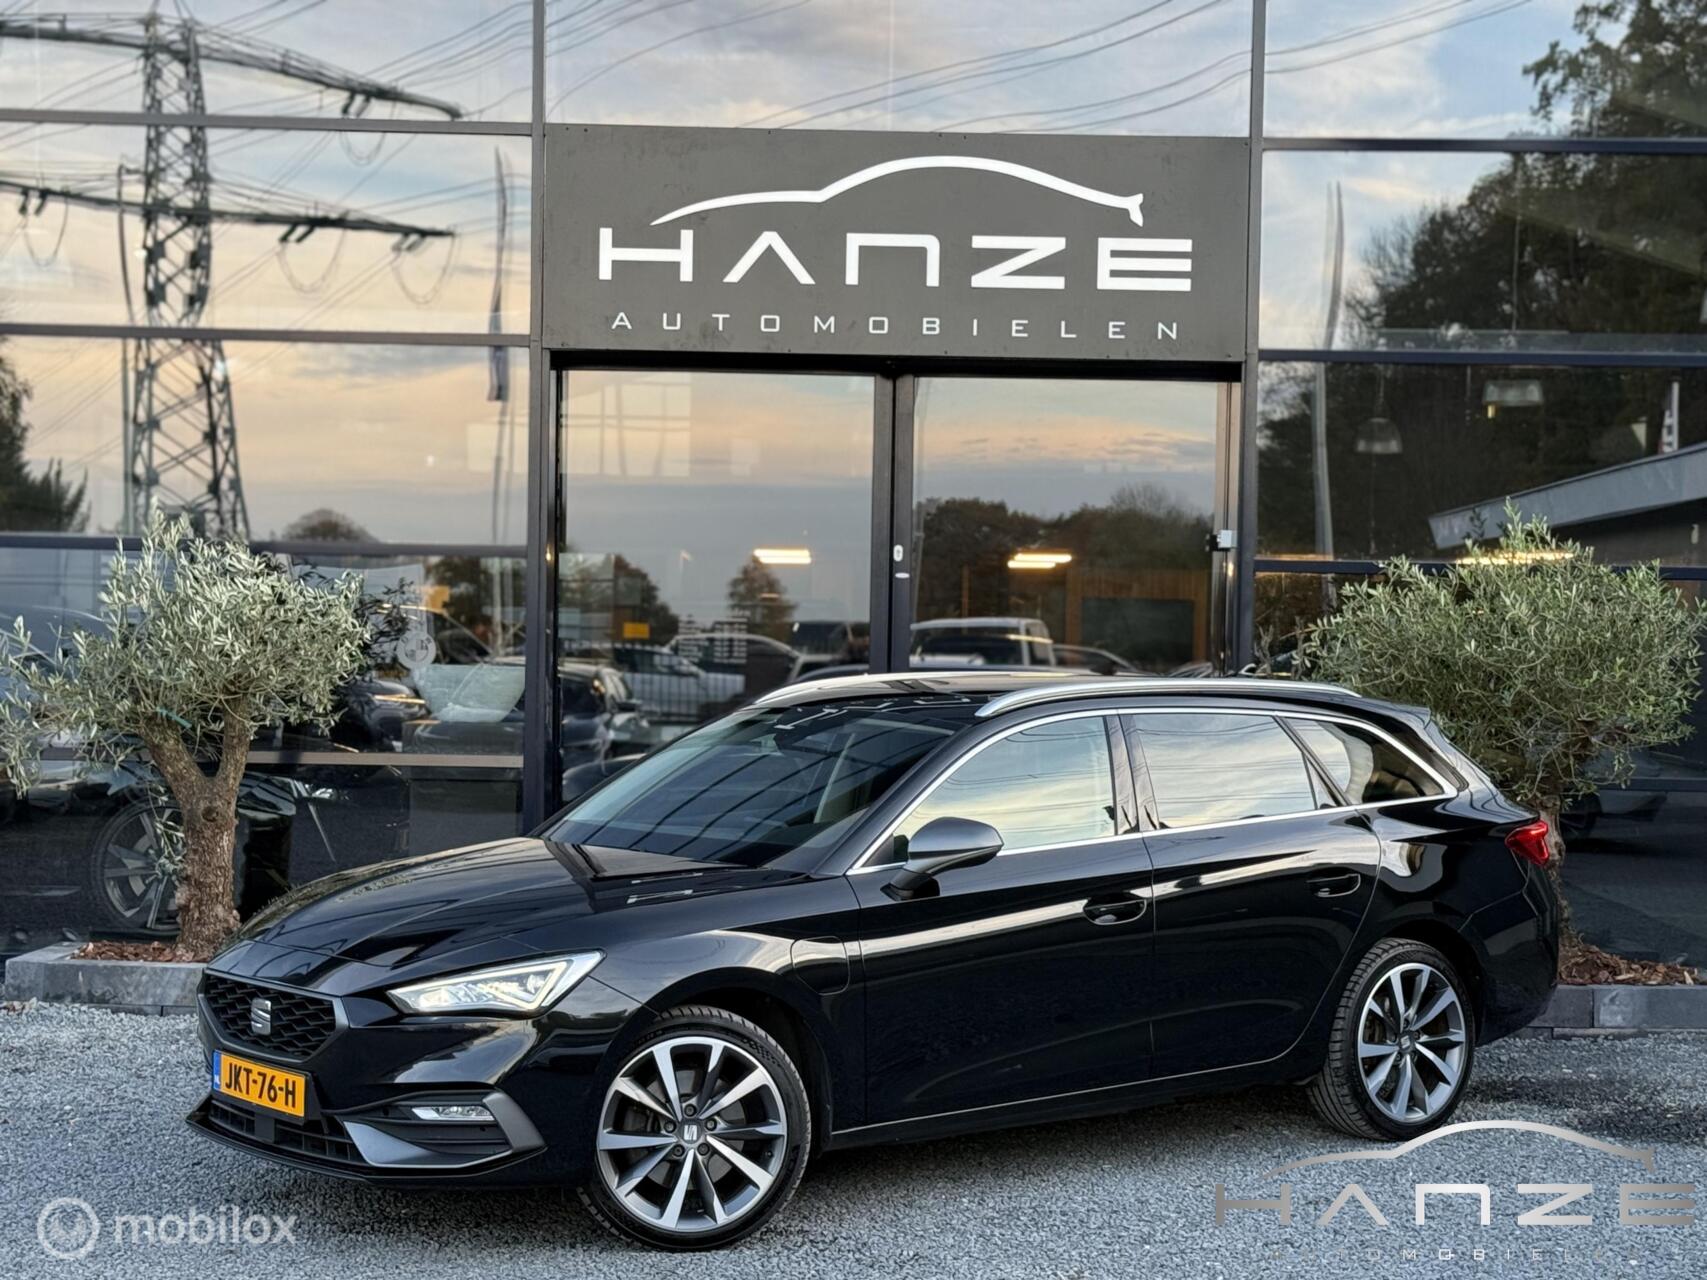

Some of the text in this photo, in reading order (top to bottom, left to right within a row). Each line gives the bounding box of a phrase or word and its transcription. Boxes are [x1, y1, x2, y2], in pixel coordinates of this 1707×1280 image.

[598, 227, 1193, 292] HANZE
[611, 311, 1177, 340] AUTOMOBIELEN
[225, 1062, 296, 1108] JKT-76-H
